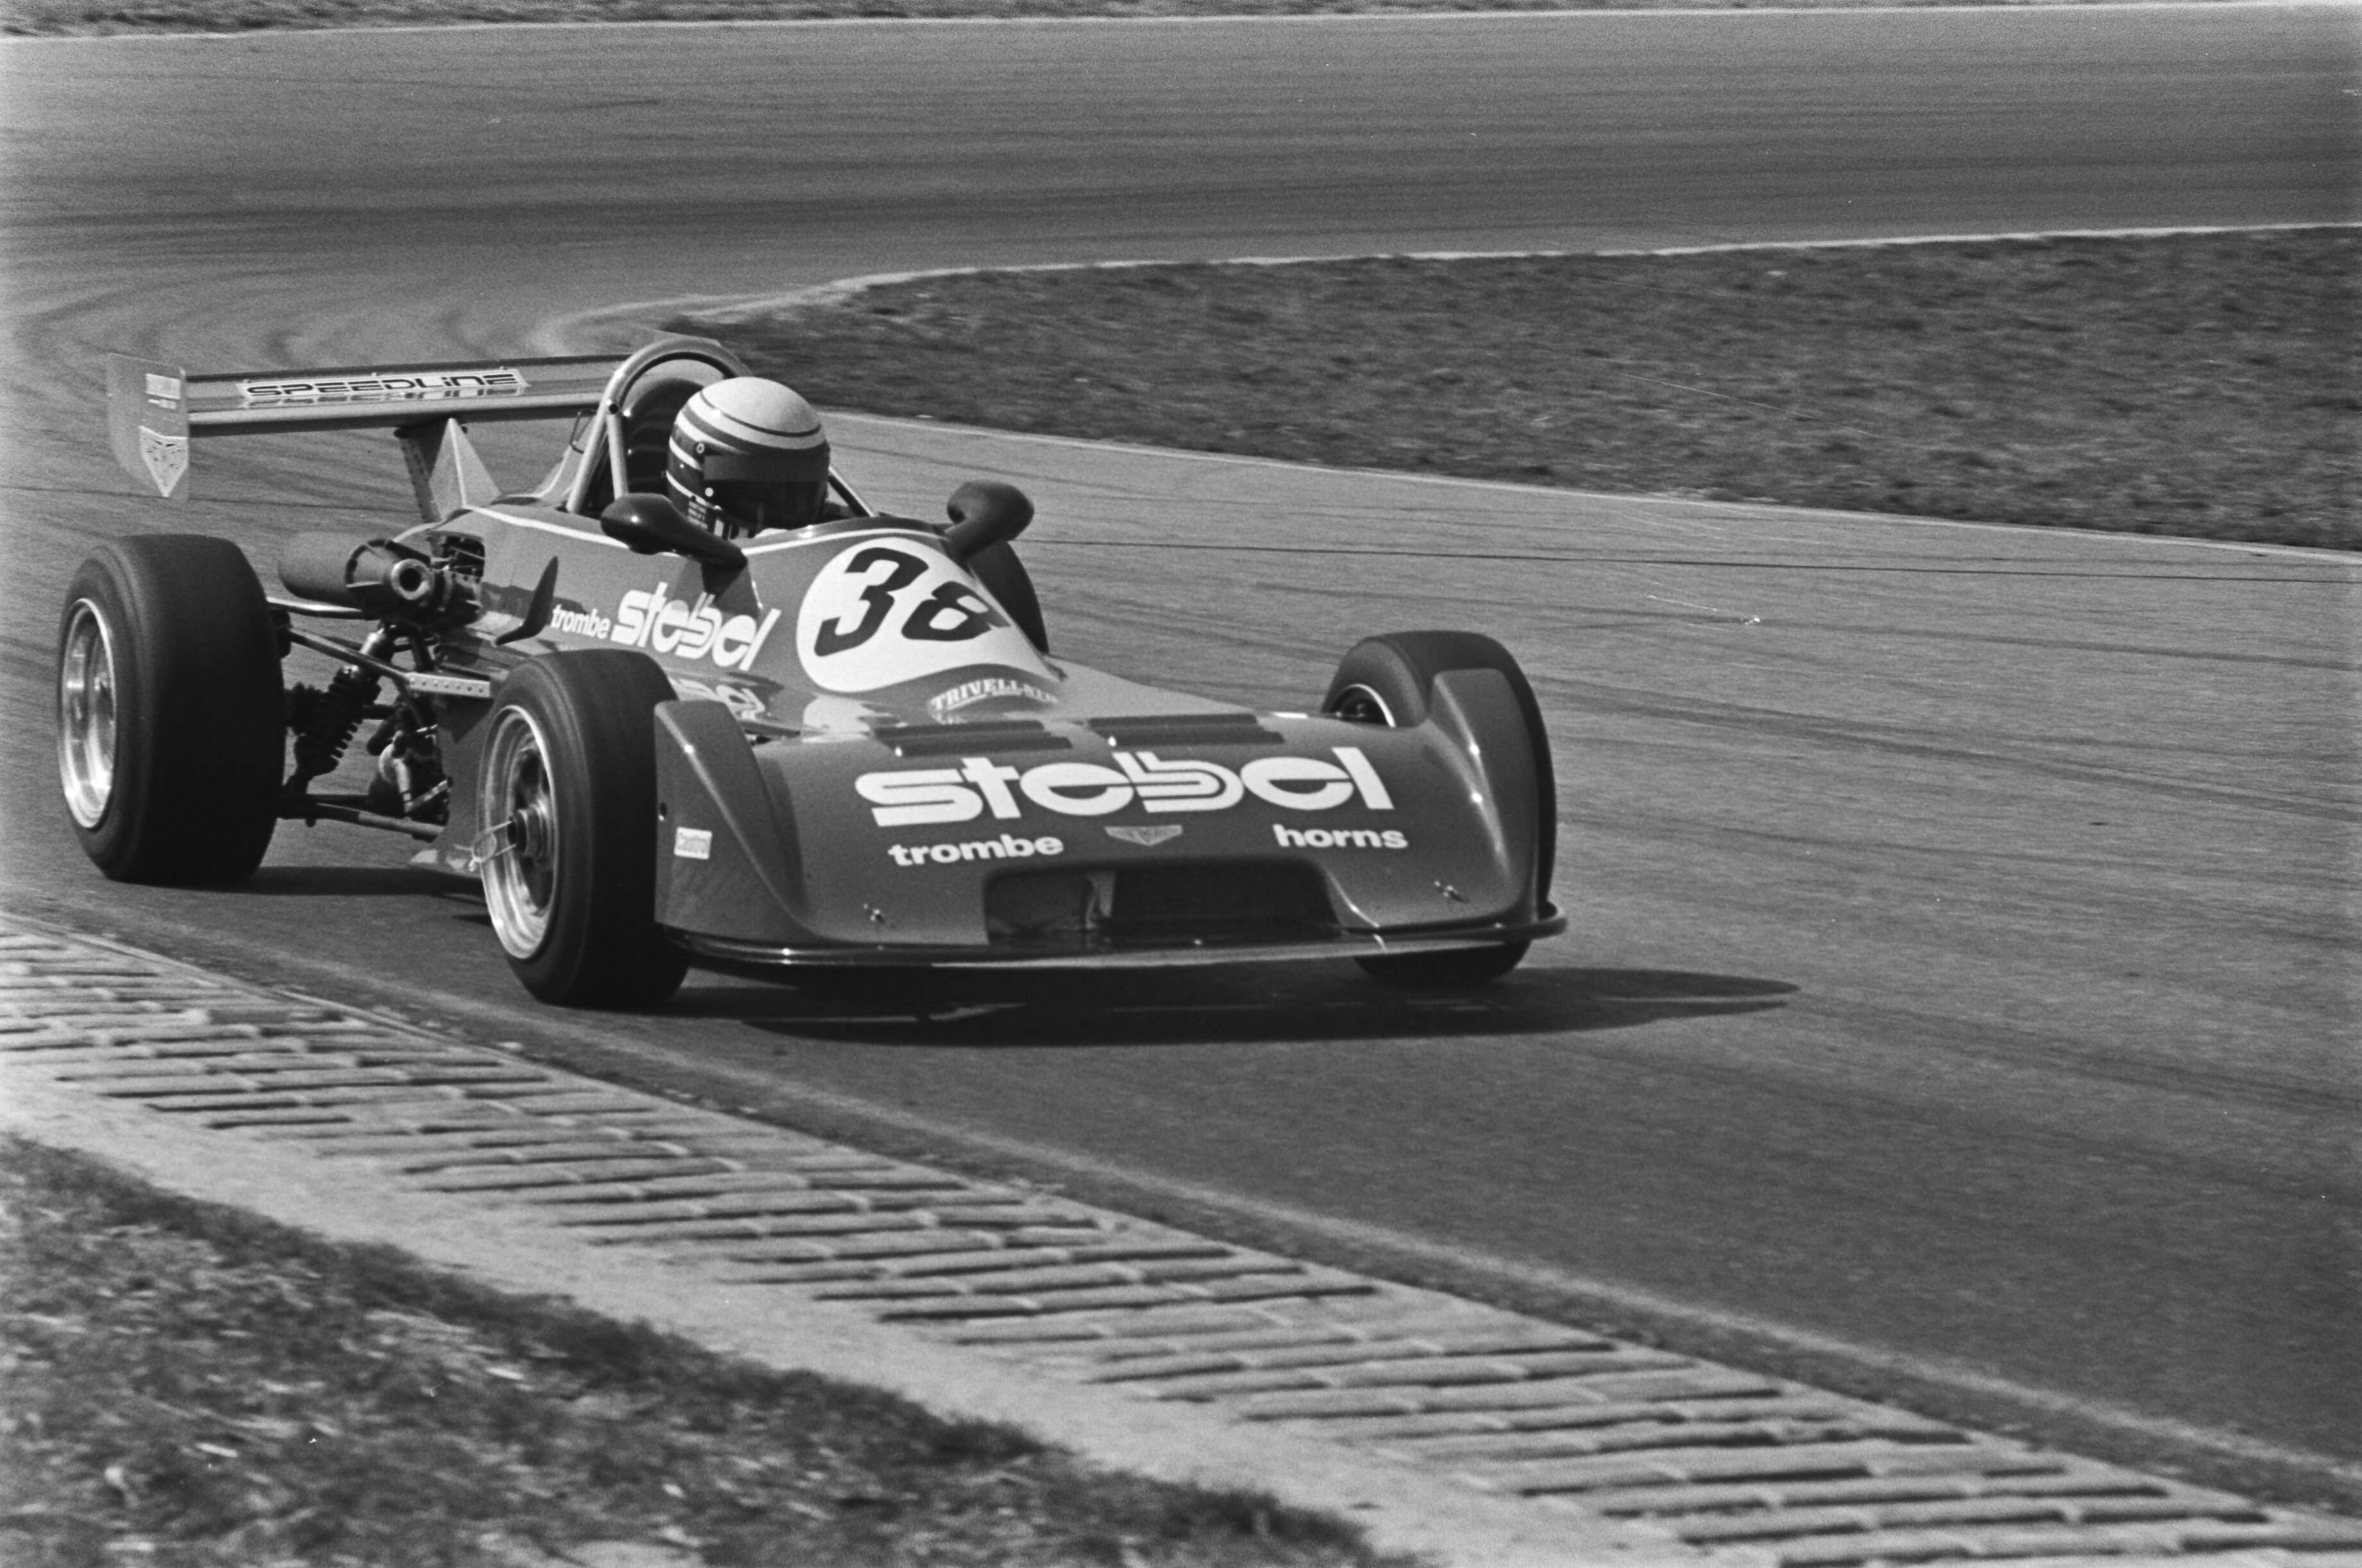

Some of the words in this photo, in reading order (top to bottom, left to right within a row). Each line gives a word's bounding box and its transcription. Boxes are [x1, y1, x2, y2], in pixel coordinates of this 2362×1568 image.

[248, 373, 520, 396] SPEEDLINE
[550, 604, 611, 639] trombe
[610, 582, 782, 671] stebel
[813, 547, 1012, 657] 38
[854, 746, 1395, 827] stebel
[888, 834, 1064, 866] trombe
[1273, 824, 1409, 850] horns
